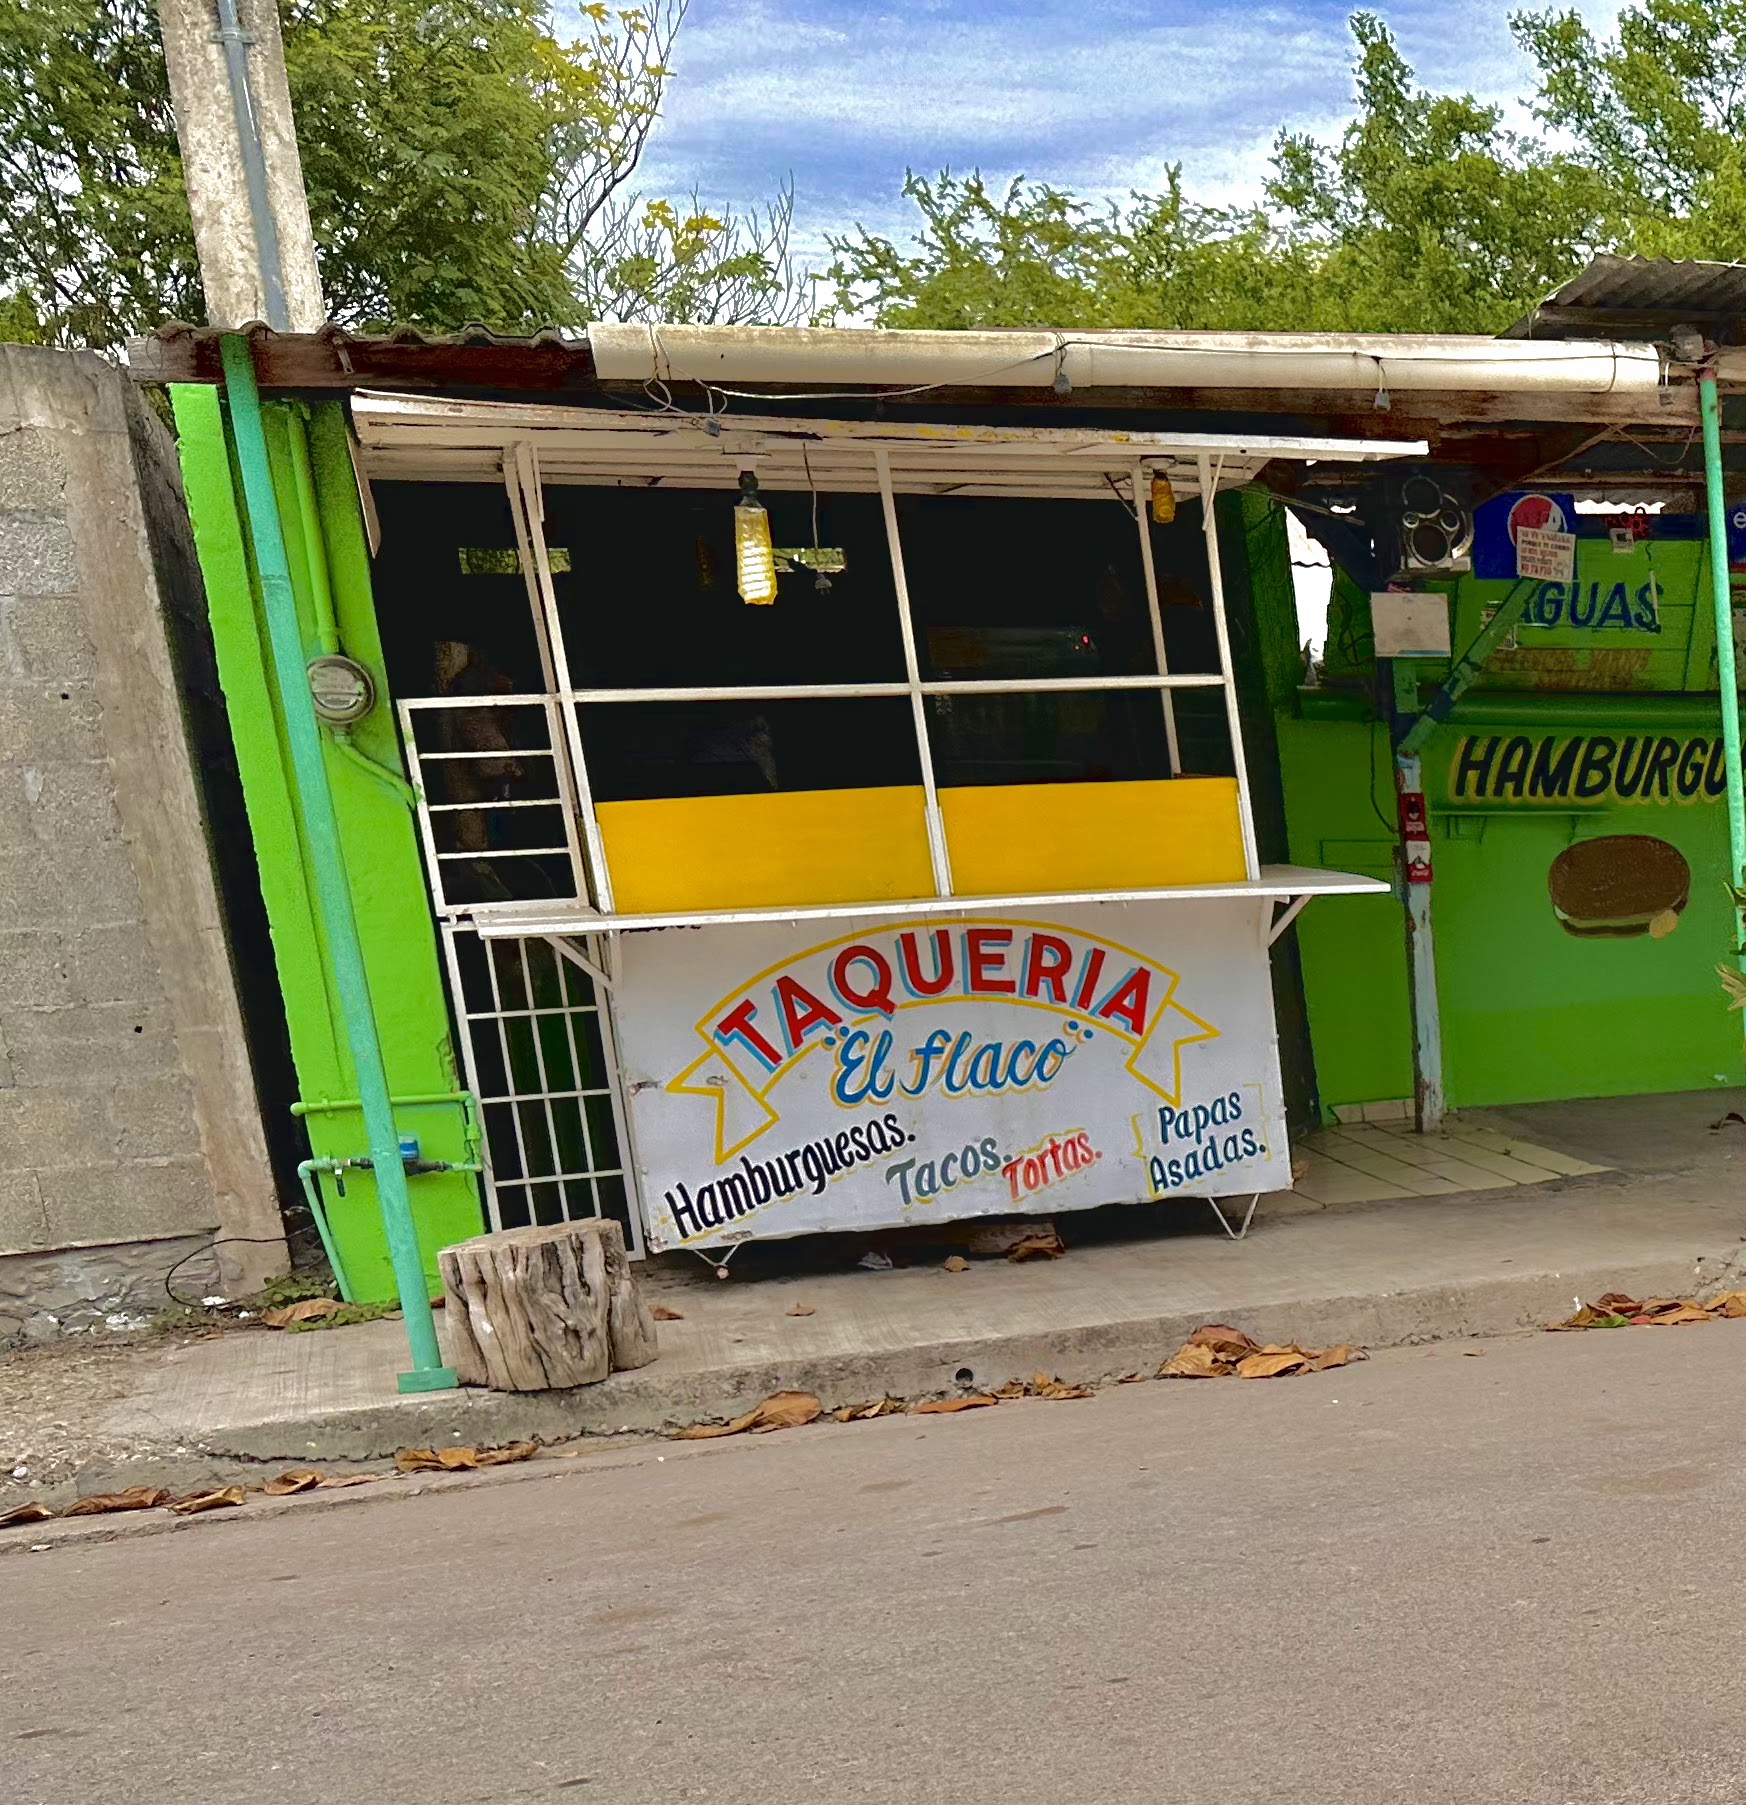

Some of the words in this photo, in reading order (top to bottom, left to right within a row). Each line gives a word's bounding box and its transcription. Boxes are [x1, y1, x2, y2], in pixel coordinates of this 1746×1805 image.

[714, 929, 1152, 1074] TAQUERIA
[1158, 1091, 1242, 1144] Papas
[663, 1112, 917, 1240] Hamburguesas.
[1002, 1131, 1103, 1201] Tortas.
[1149, 1128, 1266, 1193] Asadas.
